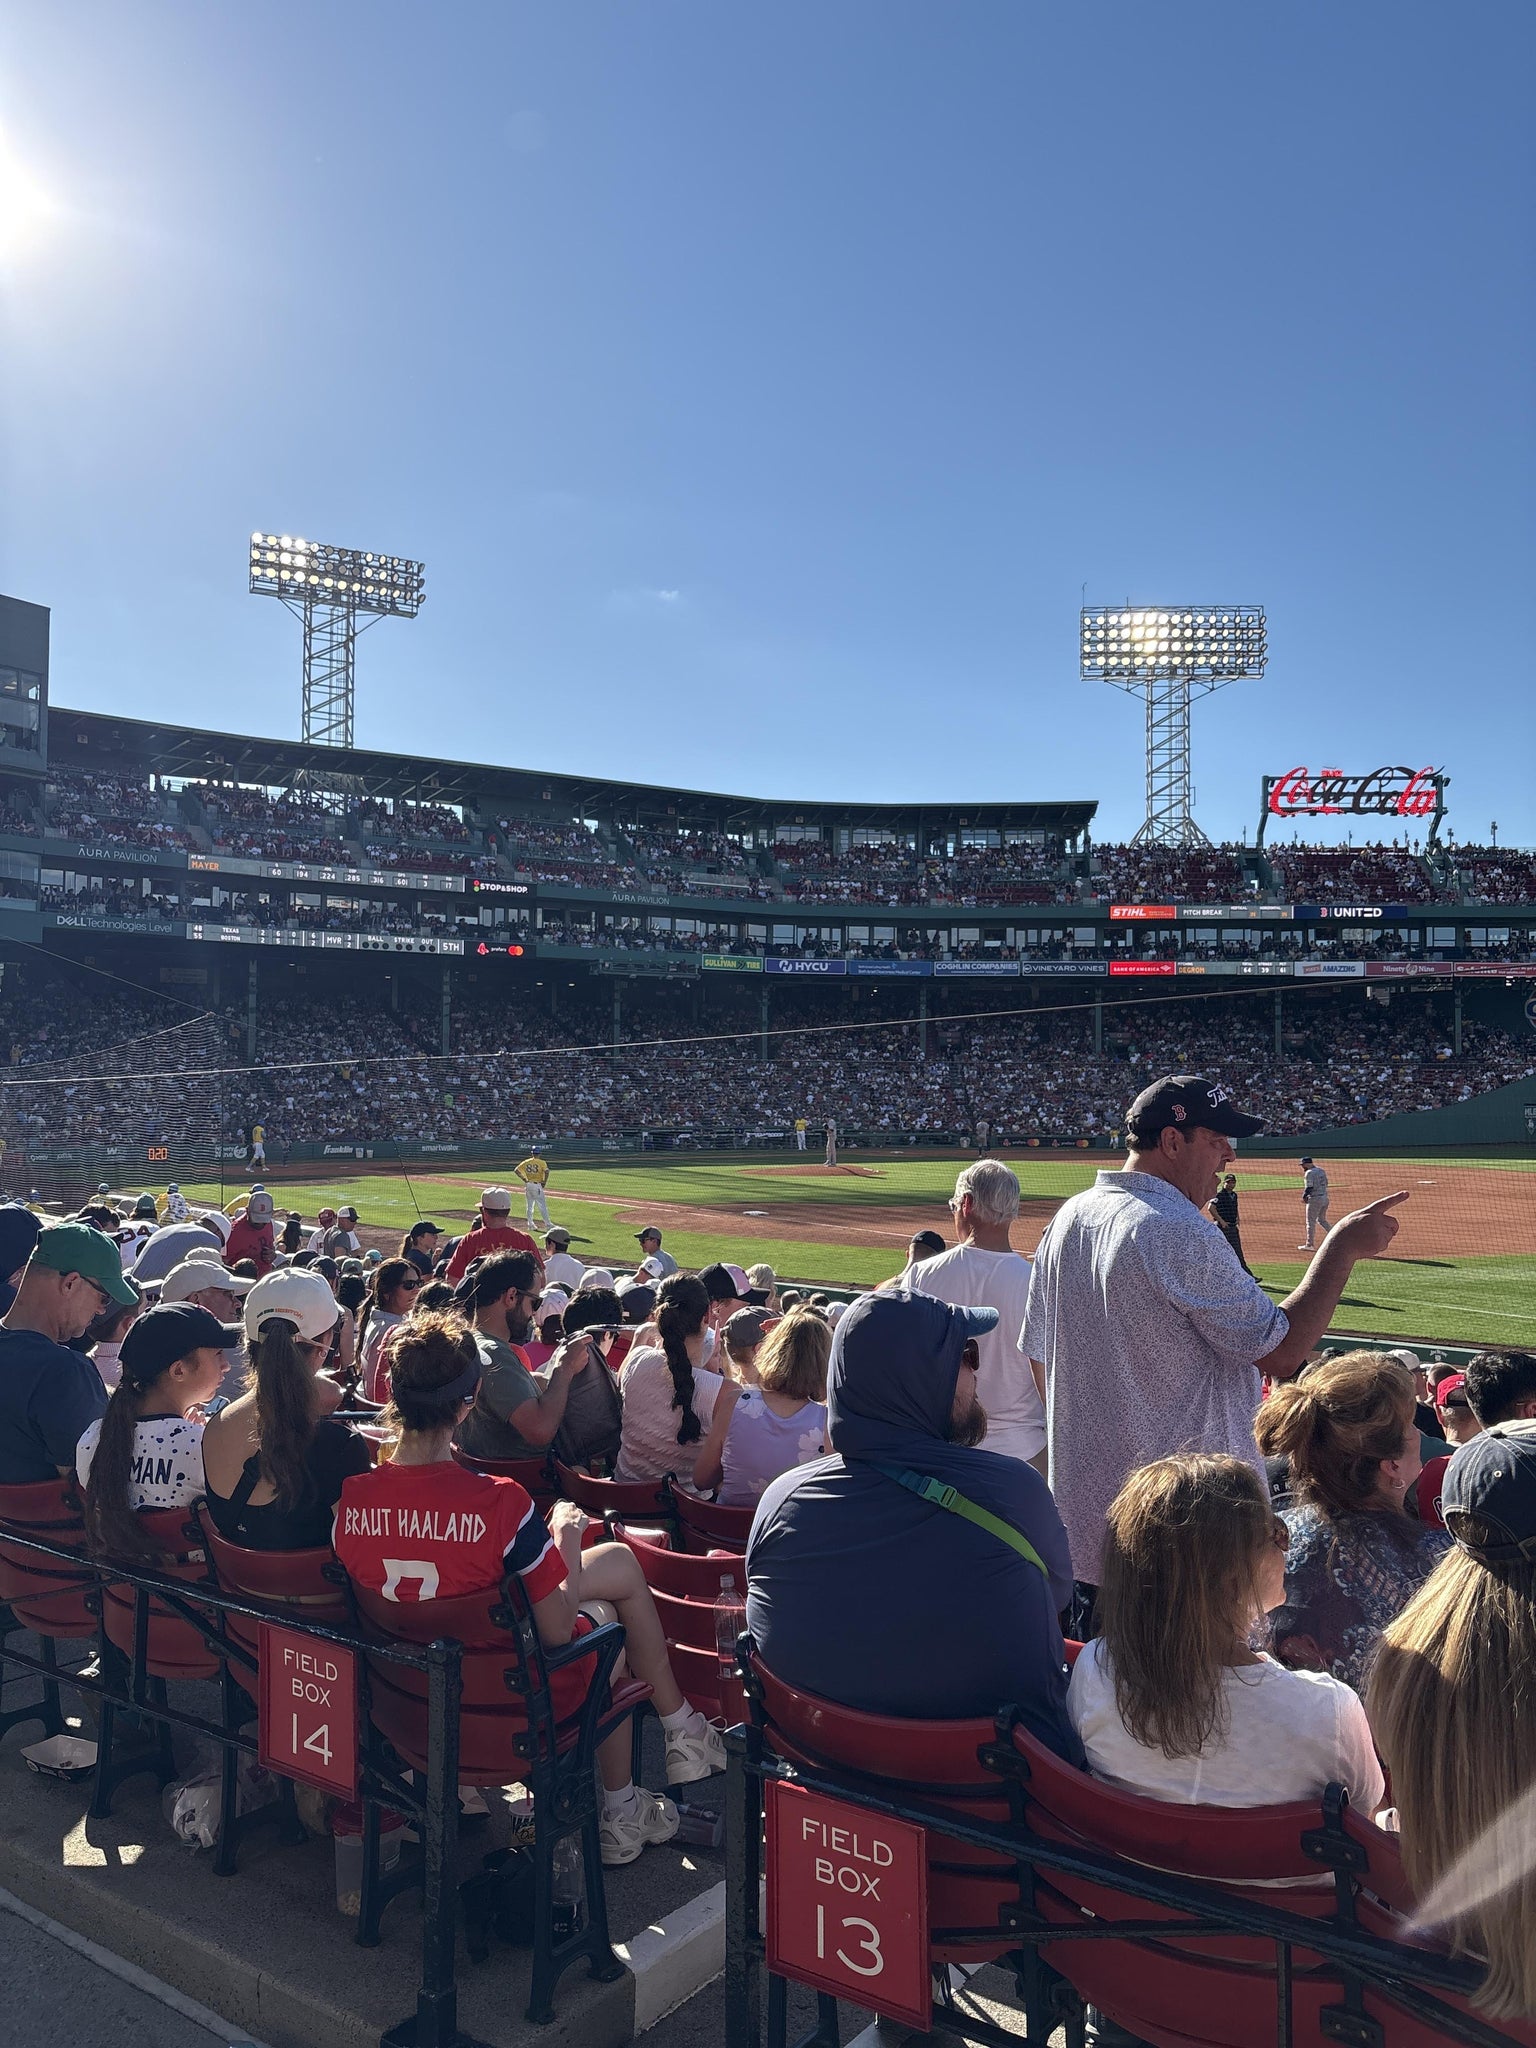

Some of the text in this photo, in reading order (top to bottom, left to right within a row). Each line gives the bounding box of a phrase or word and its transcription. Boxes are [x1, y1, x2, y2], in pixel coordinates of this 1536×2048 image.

[113, 850, 158, 863] PAVILION
[191, 860, 220, 871] MAYER
[272, 868, 282, 876] 60
[296, 870, 309, 878] 194
[320, 871, 336, 880] .224
[344, 874, 361, 882] .285
[370, 876, 384, 884] .316
[394, 878, 408, 886] .601
[637, 895, 670, 905] PAVILION
[1112, 908, 1147, 917] STIHL
[1333, 907, 1383, 918] UNITED
[56, 915, 173, 933] DELL Technologies Level
[194, 924, 203, 932] 48
[193, 932, 203, 940] 55
[326, 936, 342, 945] MVR
[394, 936, 415, 944] STRIKE
[442, 942, 460, 952] 5TH
[704, 958, 761, 969] SULLIVAN TIRE
[795, 961, 829, 972] HYCU
[1322, 965, 1356, 973] AMAZING
[1382, 965, 1406, 973] Ninety
[1171, 1103, 1187, 1122] B
[323, 1145, 354, 1155] Franklin
[526, 1163, 539, 1174] 83
[344, 1506, 487, 1543] BRAUT HAALAND
[284, 1648, 338, 1682] FIELD
[291, 1677, 331, 1708] BOX
[292, 1712, 333, 1766] 14
[802, 1817, 894, 1867] FIELD
[815, 1857, 881, 1902] BOX
[817, 1904, 884, 1976] 13
